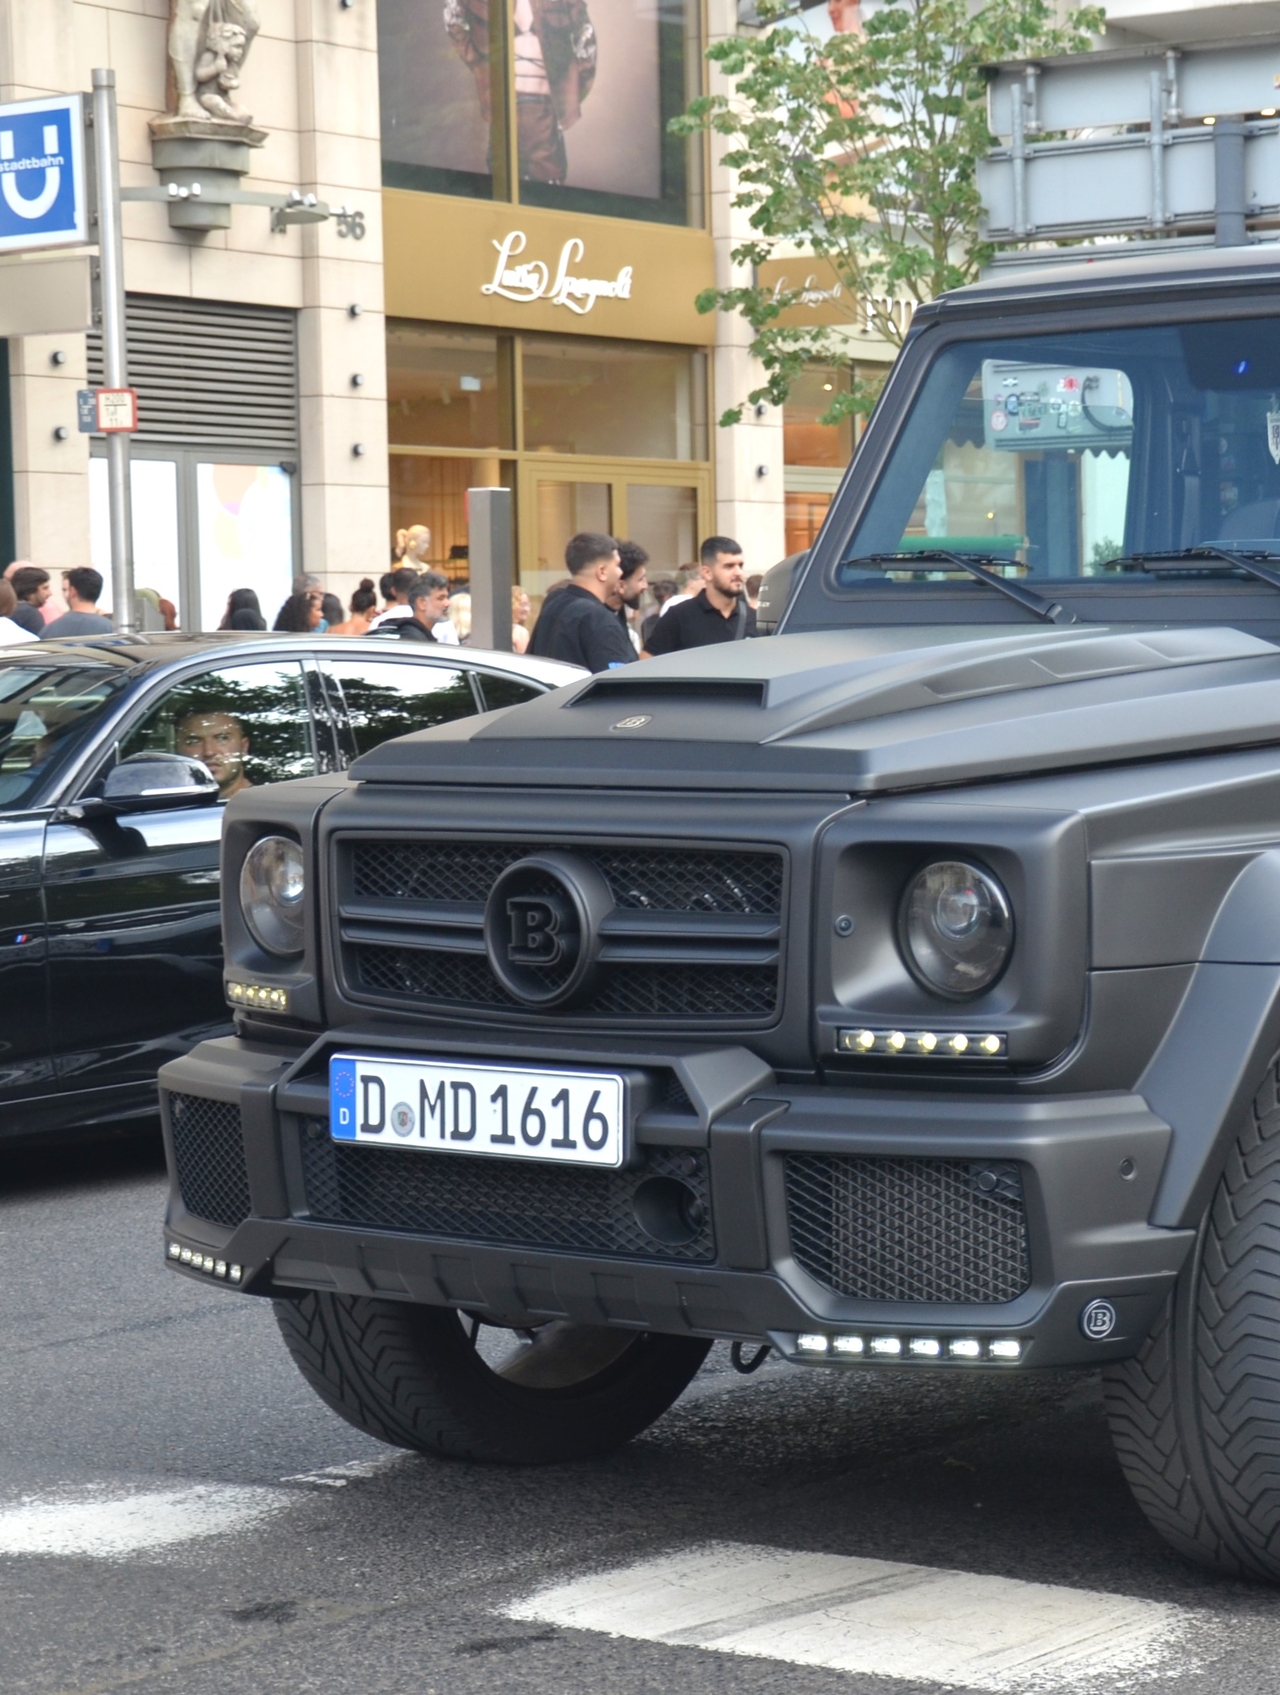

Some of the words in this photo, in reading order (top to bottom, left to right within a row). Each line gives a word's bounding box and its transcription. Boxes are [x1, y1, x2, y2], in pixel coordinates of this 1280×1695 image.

[336, 211, 366, 240] 56
[481, 231, 548, 302] Luisa
[543, 238, 633, 314] Spagnoli
[506, 896, 562, 965] B
[339, 1108, 350, 1125] D
[360, 1074, 386, 1134] D
[419, 1078, 477, 1141] MD
[490, 1083, 609, 1151] 1616
[1090, 1309, 1110, 1331] B
